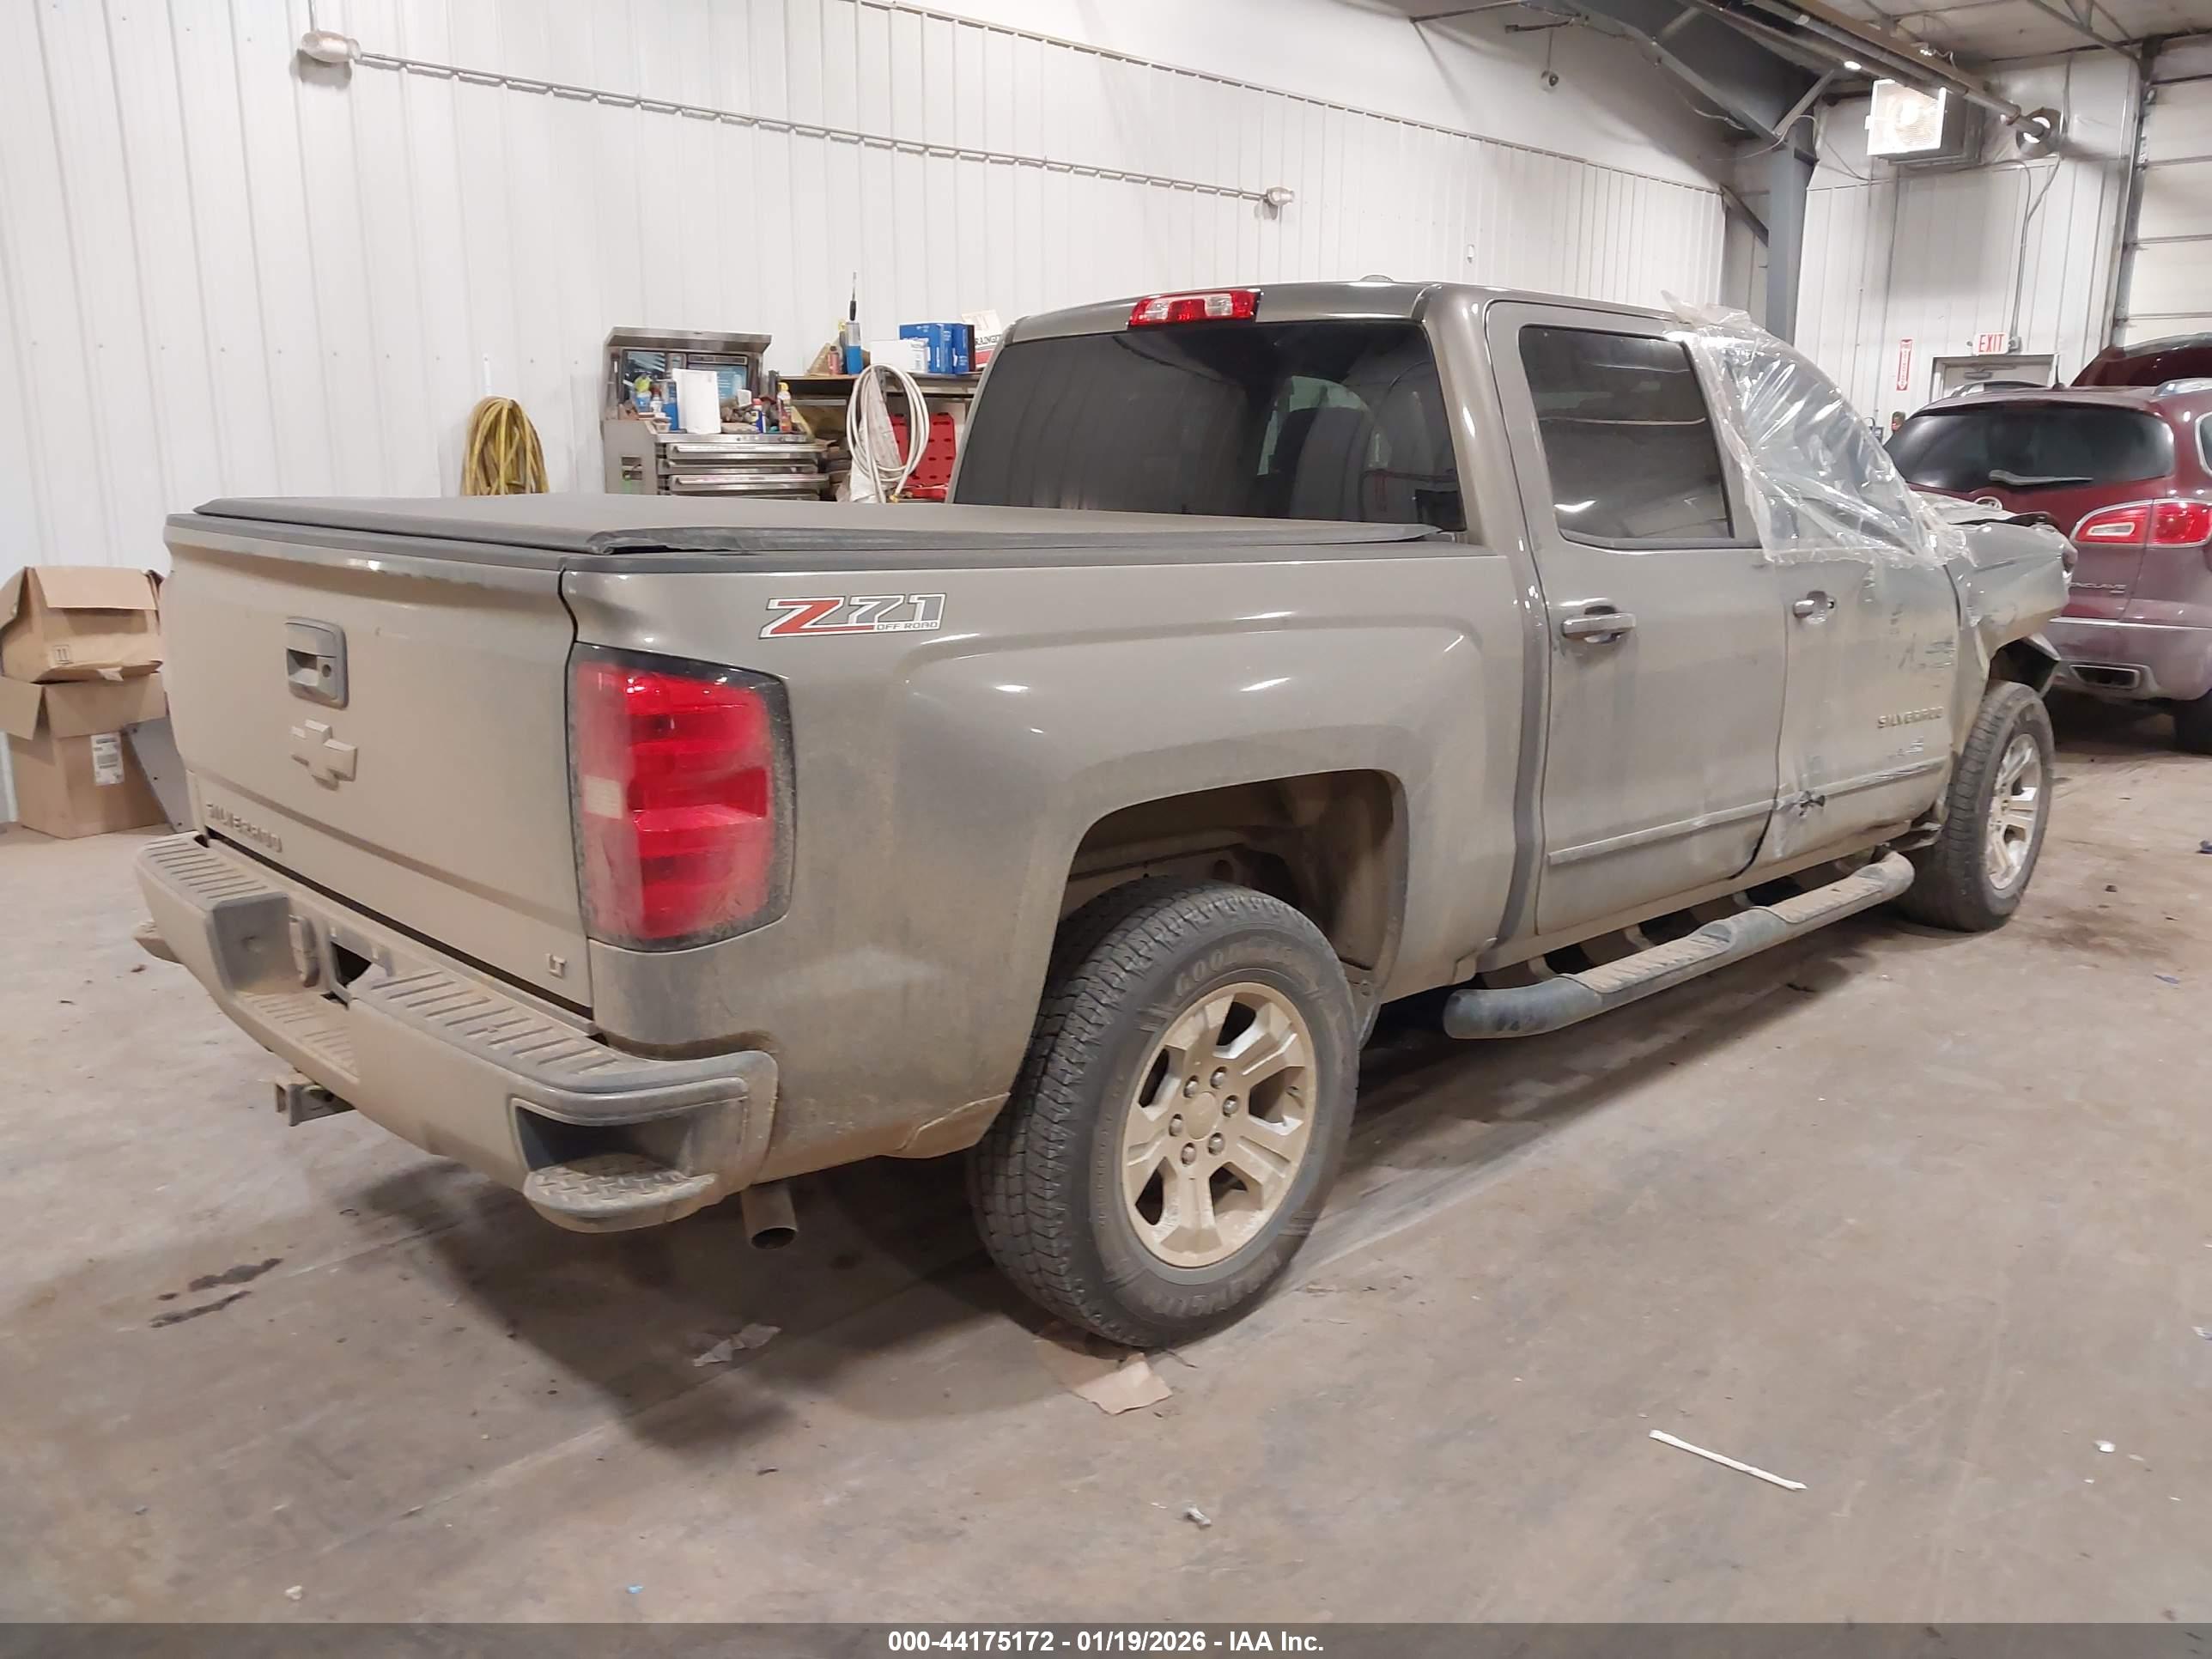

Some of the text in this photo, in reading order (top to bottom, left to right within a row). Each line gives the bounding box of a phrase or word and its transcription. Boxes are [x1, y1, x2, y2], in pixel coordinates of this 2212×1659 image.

[1978, 333, 2005, 353] EXIT
[758, 592, 946, 639] Z71
[877, 621, 939, 631] OFF ROAD
[544, 952, 568, 980] LT
